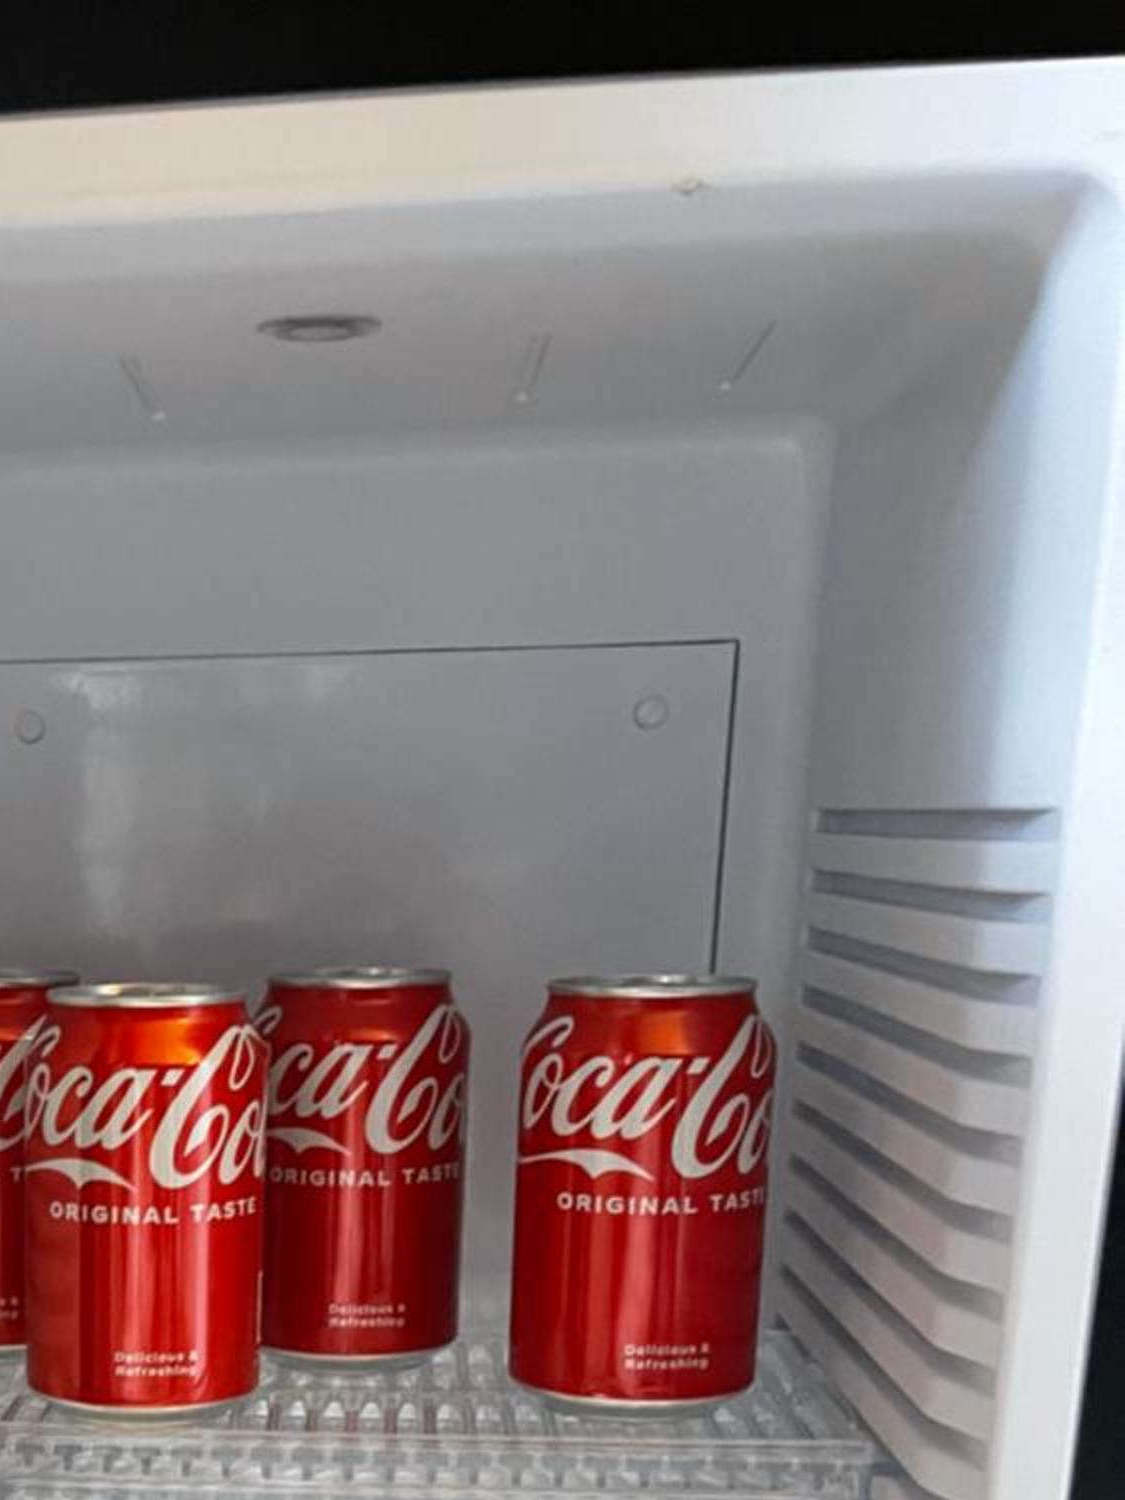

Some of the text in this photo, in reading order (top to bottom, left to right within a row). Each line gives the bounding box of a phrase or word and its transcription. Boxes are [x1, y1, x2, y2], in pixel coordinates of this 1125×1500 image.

[268, 1167, 392, 1188] ORIGINAL
[49, 1196, 257, 1225] ORIGINAL TASTE
[557, 1191, 699, 1216] ORIGINAL
